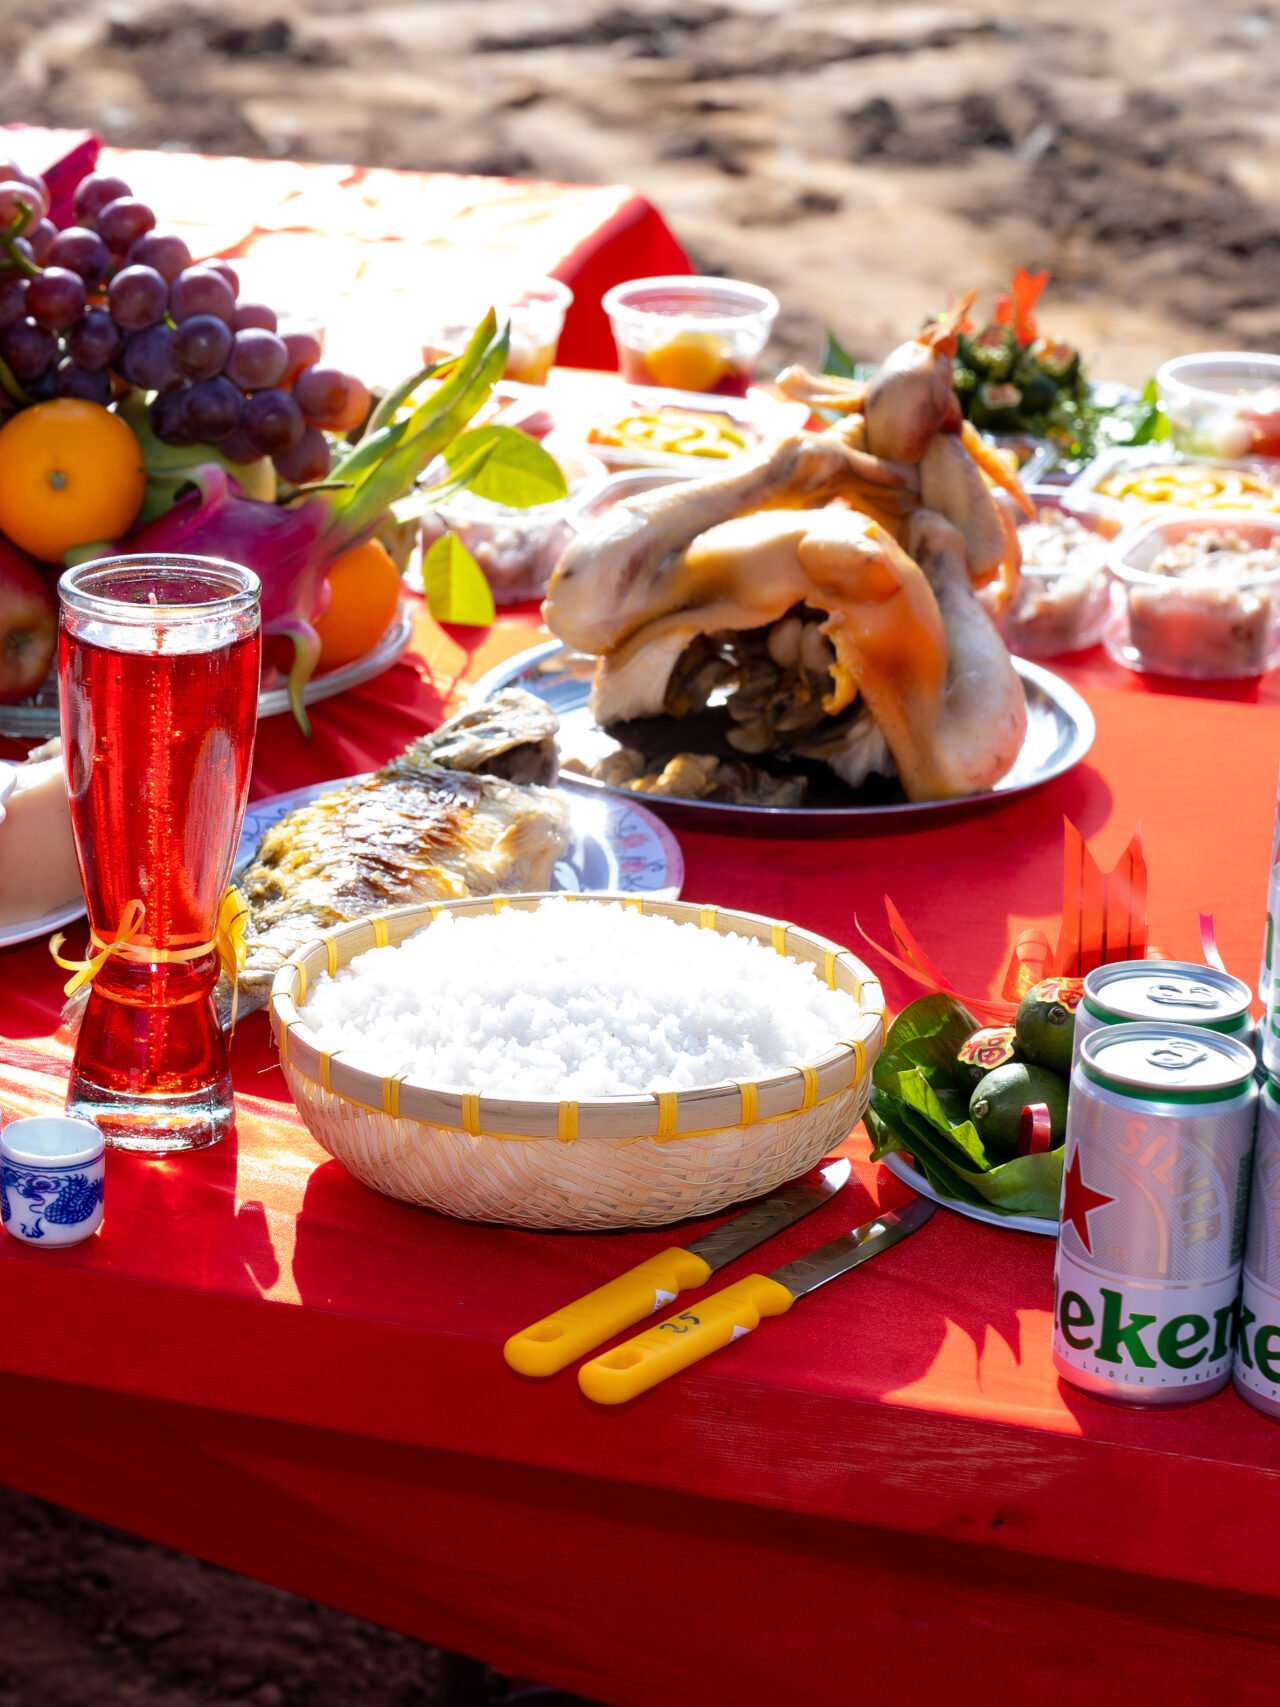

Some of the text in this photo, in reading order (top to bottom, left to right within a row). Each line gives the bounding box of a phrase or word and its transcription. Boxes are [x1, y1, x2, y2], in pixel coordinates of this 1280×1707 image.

[960, 1030, 1011, 1066] 福
[1117, 1119, 1222, 1248] SILVER
[1054, 1287, 1237, 1369] eken
[1082, 1361, 1145, 1383] LAGER
